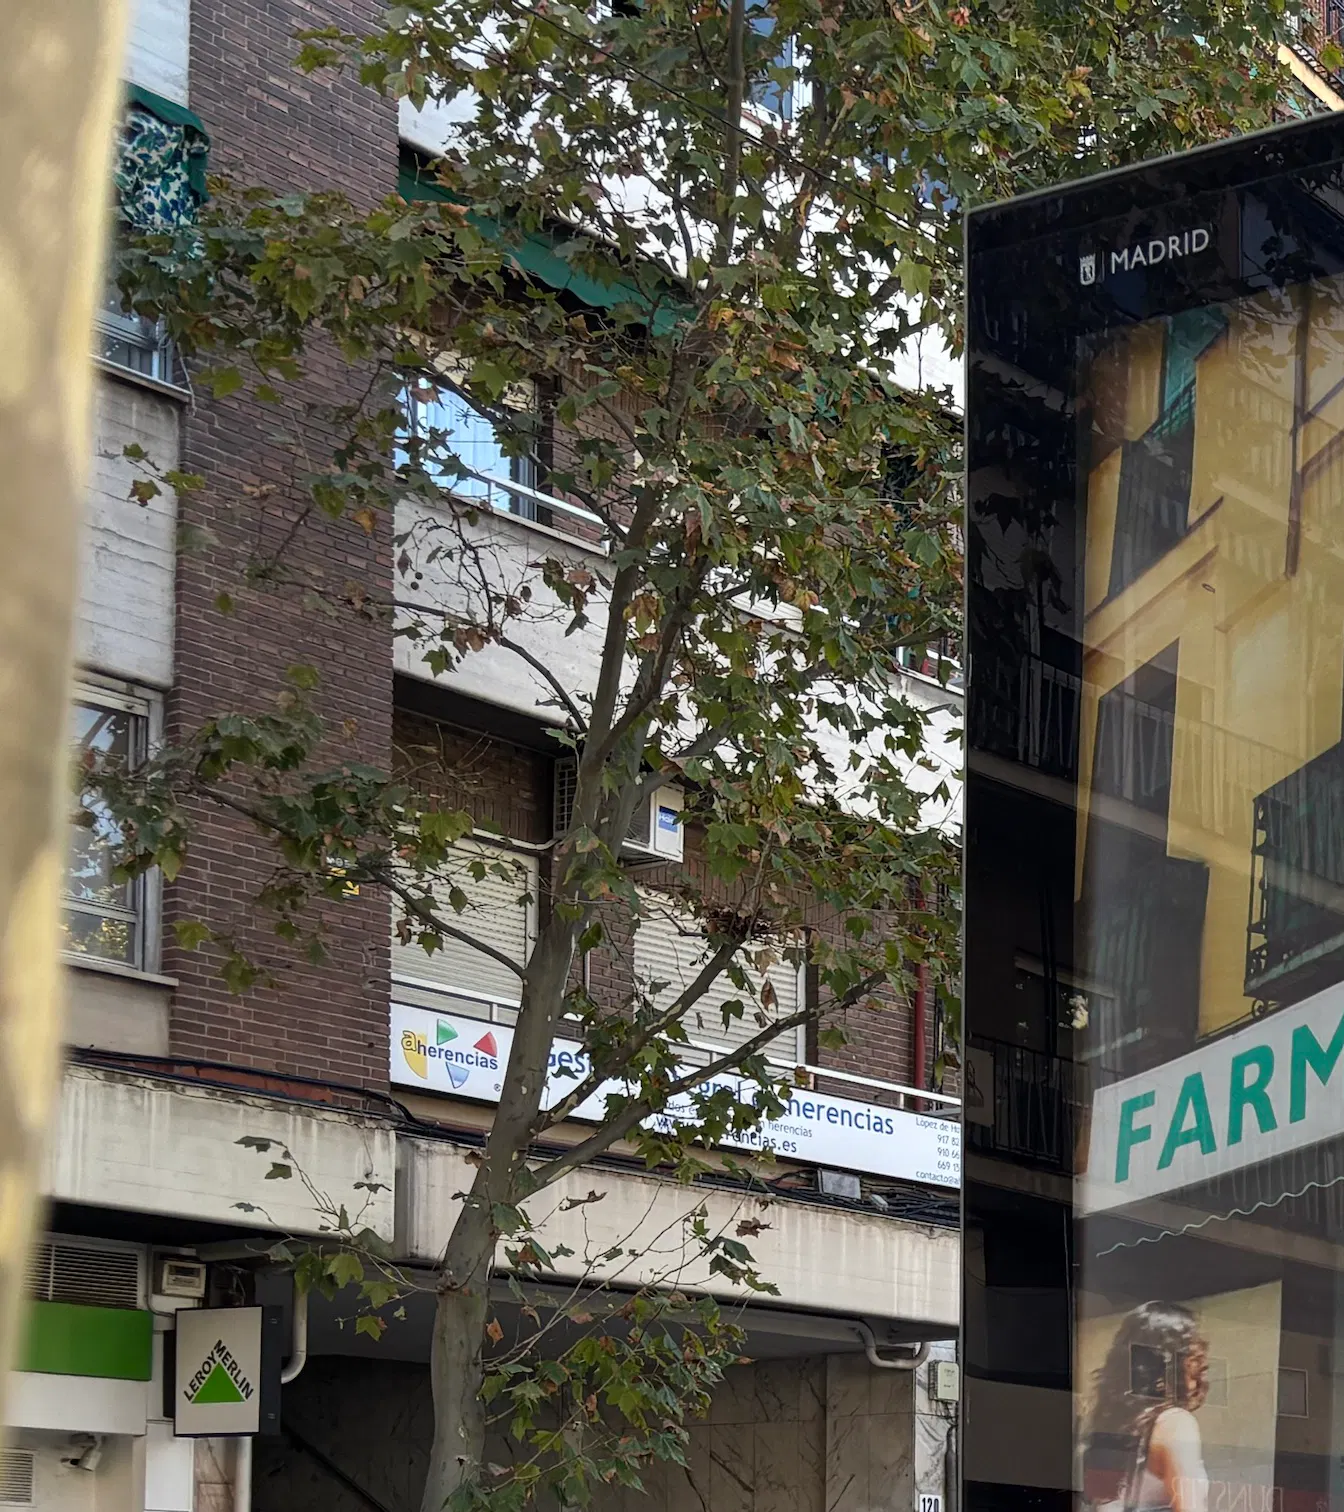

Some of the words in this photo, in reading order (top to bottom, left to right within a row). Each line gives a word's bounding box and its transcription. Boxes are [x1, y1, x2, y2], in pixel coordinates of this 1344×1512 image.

[1111, 229, 1208, 274] MADRID
[184, 1350, 217, 1402] LEROY
[213, 1339, 254, 1400] MERLIN
